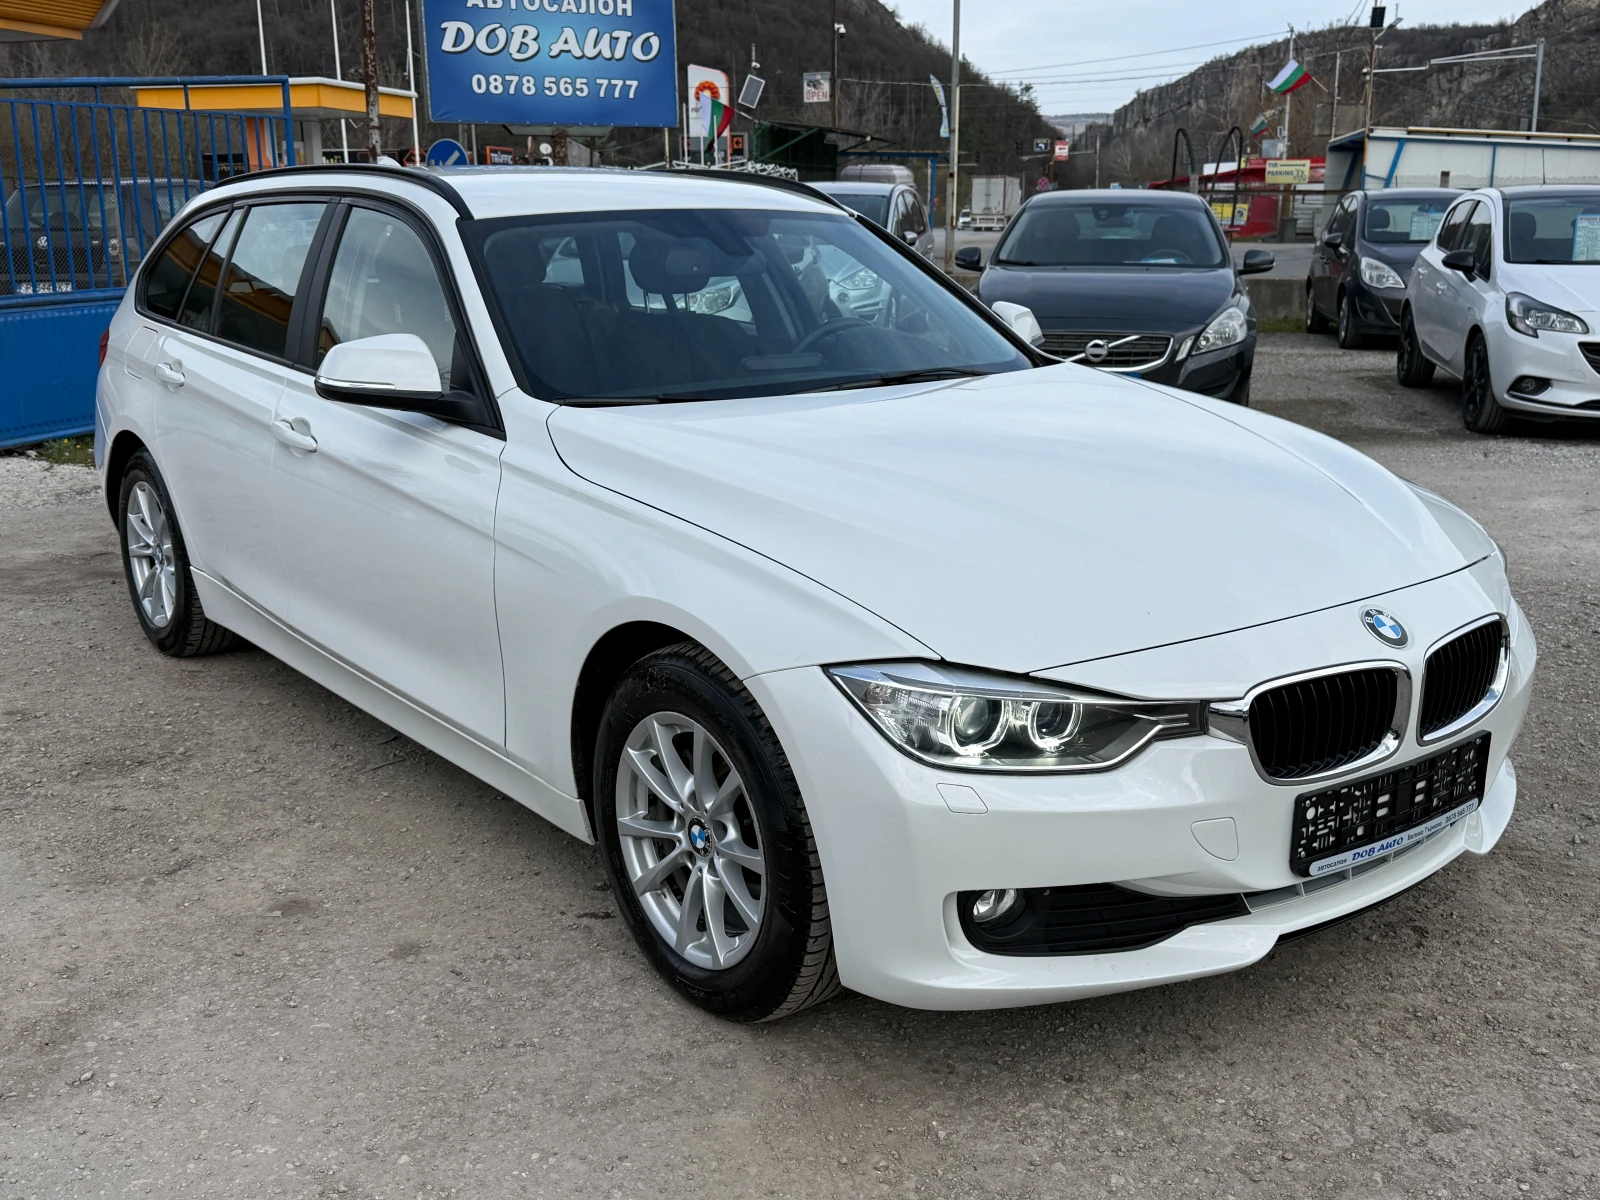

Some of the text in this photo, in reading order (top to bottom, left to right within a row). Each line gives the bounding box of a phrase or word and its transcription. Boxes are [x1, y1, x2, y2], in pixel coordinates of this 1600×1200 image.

[440, 20, 661, 61] DOB AUTO
[471, 73, 639, 99] 0878 565 777
[805, 90, 828, 101] OPEN
[1317, 858, 1347, 872] автосалон
[1351, 846, 1376, 861] DOB
[1377, 836, 1404, 853] AUTO
[1407, 830, 1424, 841] Велико
